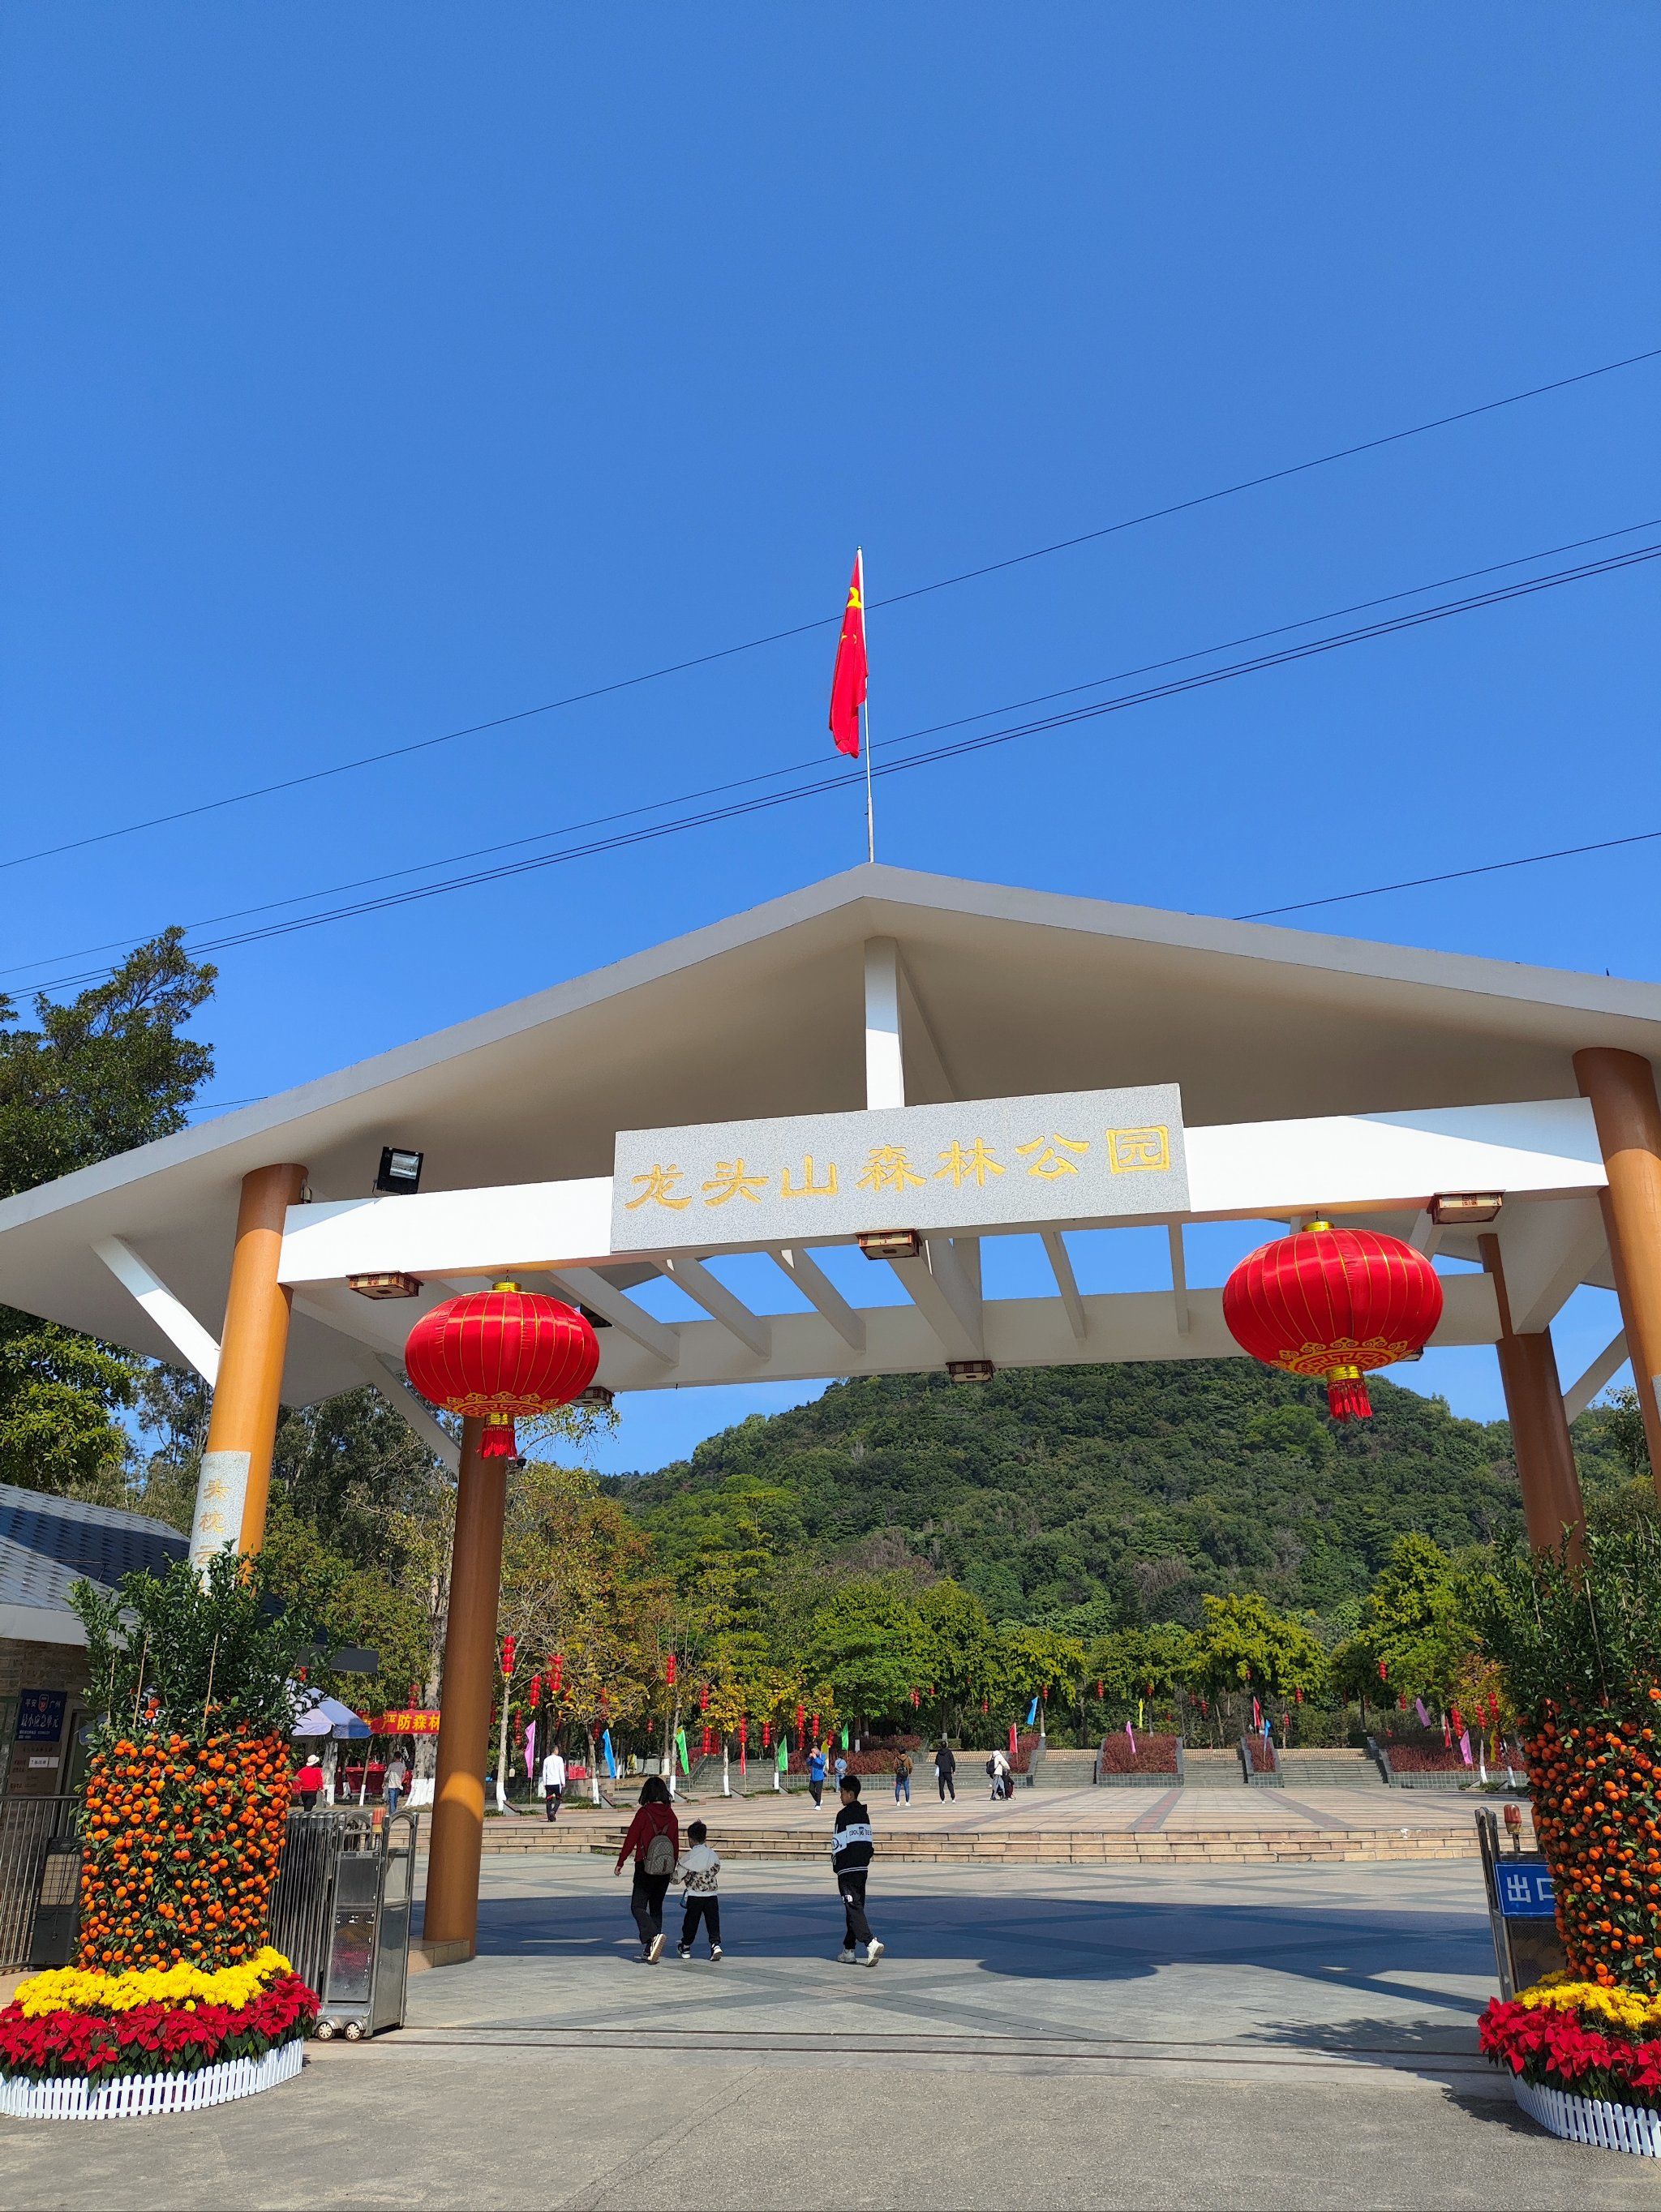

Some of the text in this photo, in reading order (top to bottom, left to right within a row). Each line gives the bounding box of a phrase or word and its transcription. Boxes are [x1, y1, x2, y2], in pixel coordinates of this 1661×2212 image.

[624, 1125, 1170, 1210] 龙头山森林公园
[194, 1478, 230, 1597] 头枕云
[25, 1698, 37, 1708] 平安
[1507, 1874, 1556, 1903] 出口
